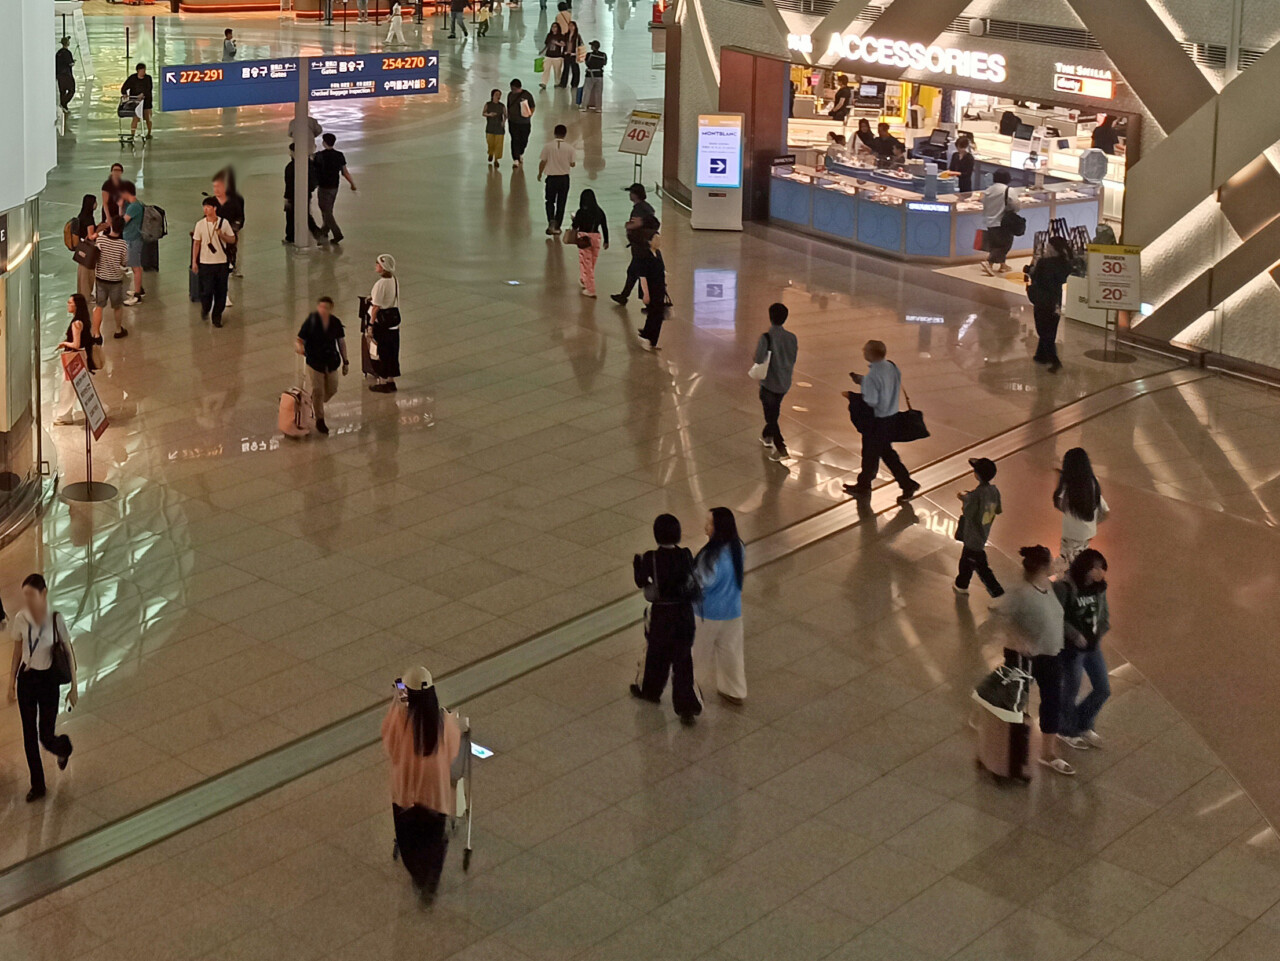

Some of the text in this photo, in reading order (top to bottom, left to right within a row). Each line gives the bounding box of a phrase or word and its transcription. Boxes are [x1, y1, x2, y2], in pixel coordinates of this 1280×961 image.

[339, 56, 425, 72] 탑승구 254-270
[827, 32, 1007, 83] ACCESSORIES
[179, 66, 268, 83] 272-291 탑승구
[1055, 62, 1112, 79] THE SHILLA
